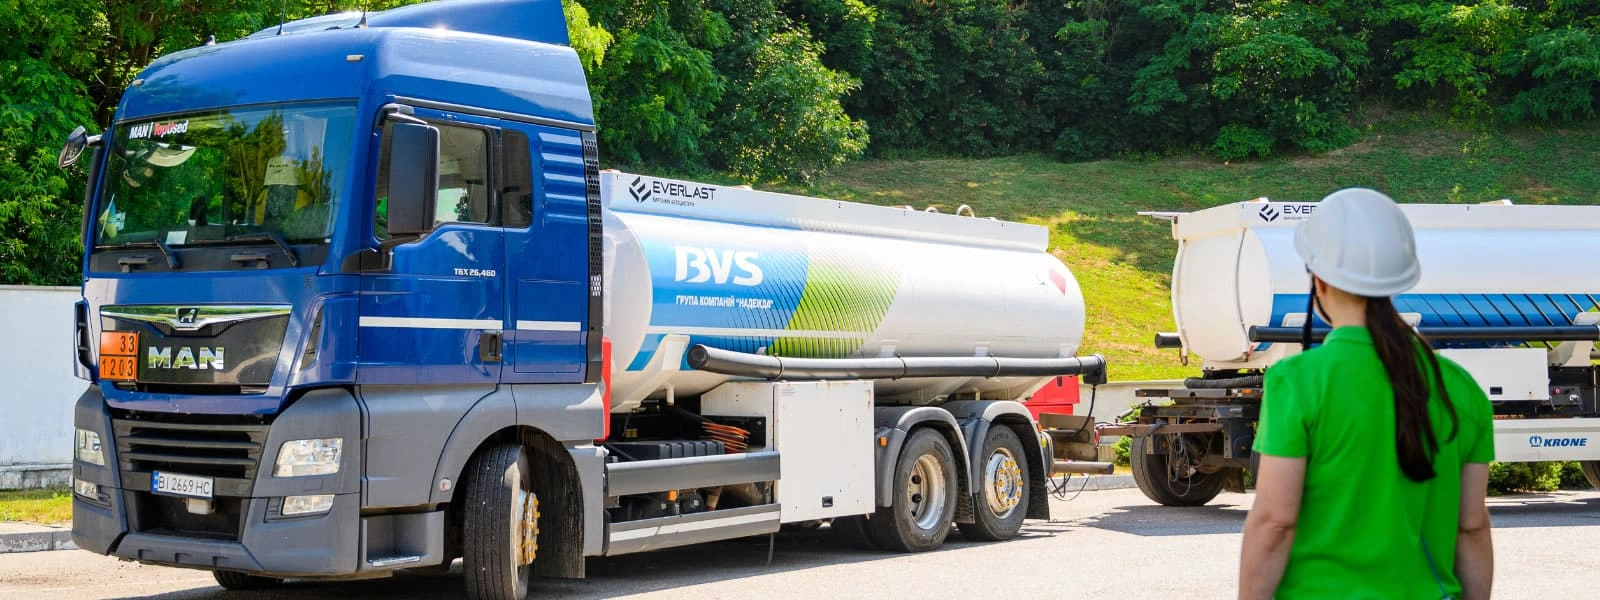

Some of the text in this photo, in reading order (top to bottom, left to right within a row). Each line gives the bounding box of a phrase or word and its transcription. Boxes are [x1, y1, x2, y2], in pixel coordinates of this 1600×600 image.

[129, 124, 149, 139] MAN
[652, 181, 716, 200] EVERLAST
[675, 246, 764, 286] BVS
[675, 295, 698, 306] ГРУПА
[699, 295, 735, 307] КОМПАНІЙ
[120, 335, 135, 353] 33
[148, 346, 225, 370] MAN
[101, 359, 135, 377] 1203
[1543, 438, 1588, 448] KRONE
[158, 476, 210, 495] BI 2669 HC
